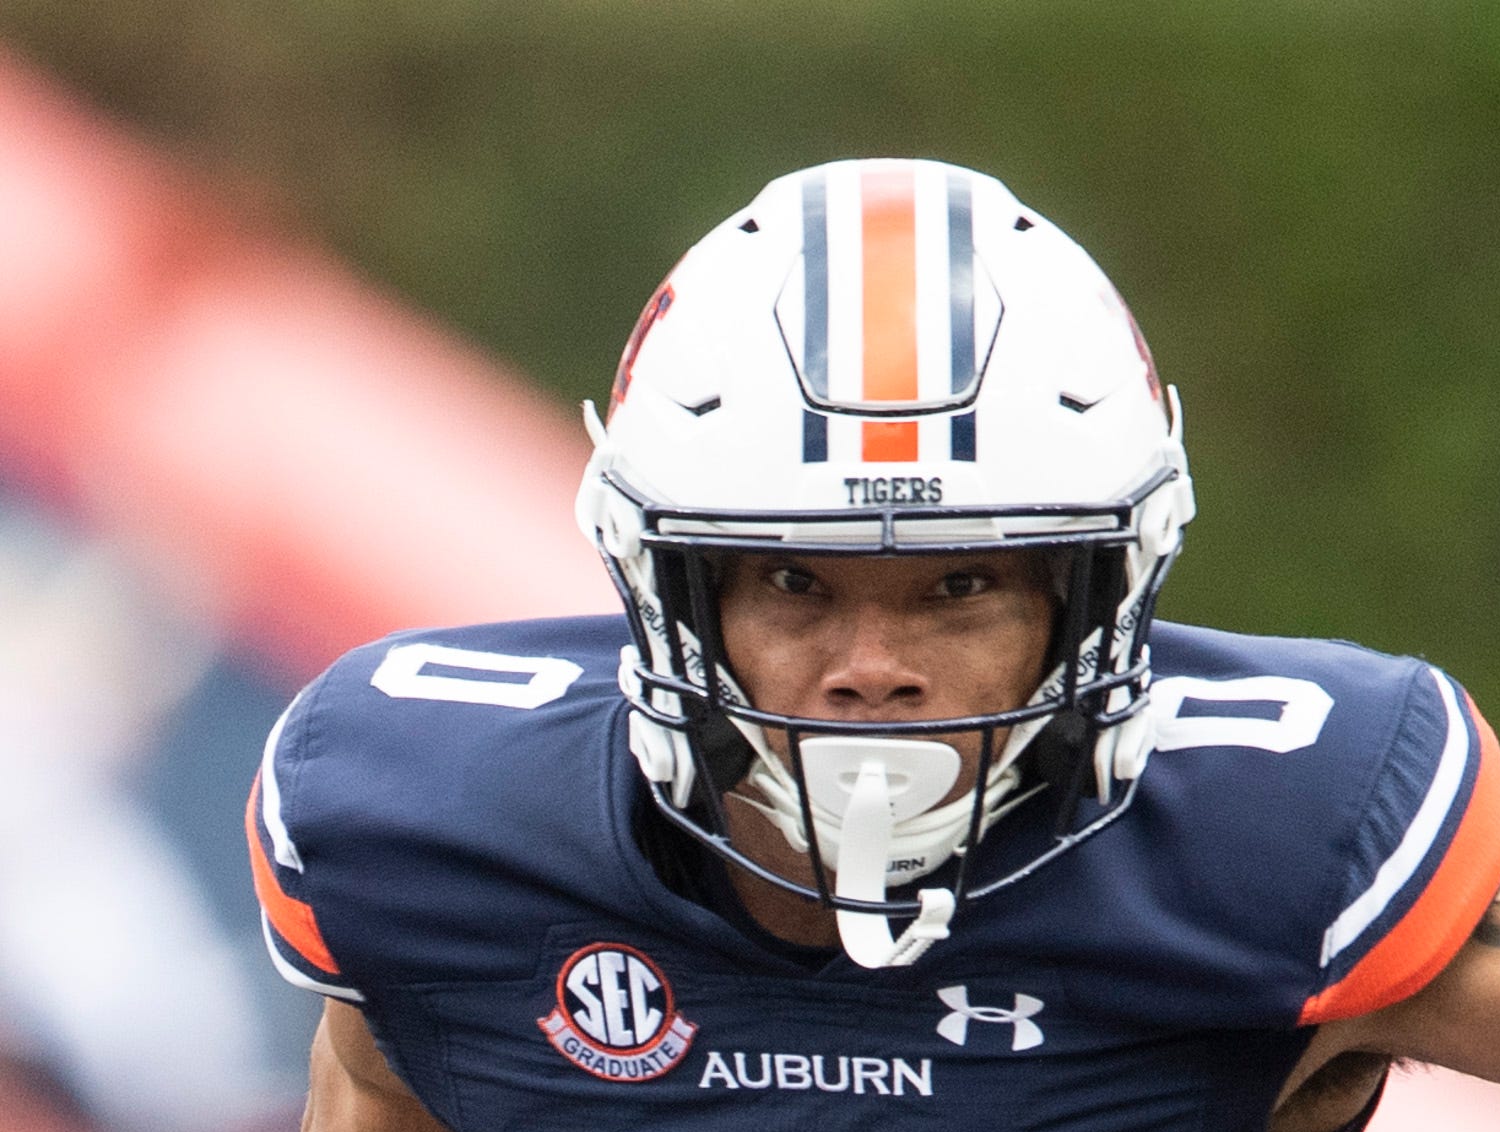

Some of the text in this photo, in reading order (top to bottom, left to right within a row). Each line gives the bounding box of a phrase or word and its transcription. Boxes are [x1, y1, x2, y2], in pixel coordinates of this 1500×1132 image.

[844, 477, 942, 504] TIGERS
[370, 643, 584, 709] 0
[1149, 675, 1335, 753] 0
[566, 950, 663, 1047] SEC
[562, 1035, 679, 1079] GRADUATE
[699, 1051, 933, 1096] AUBURN
